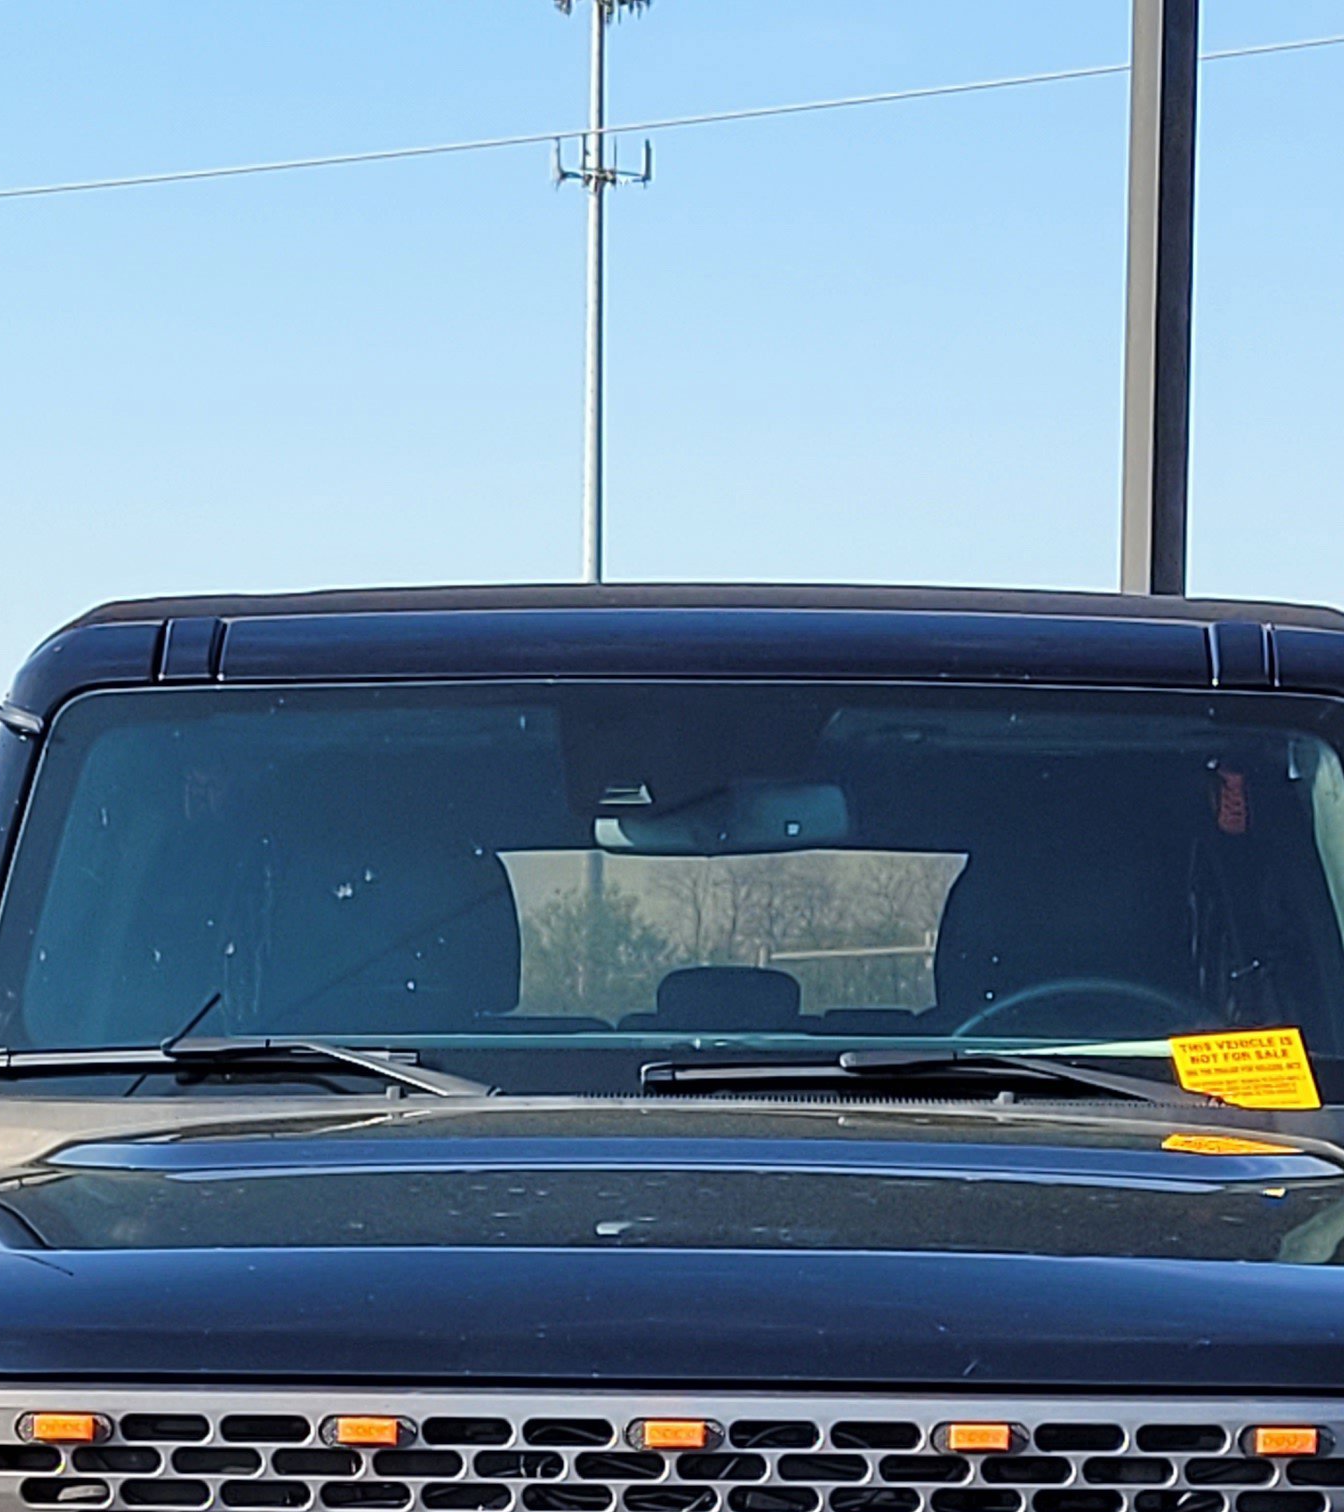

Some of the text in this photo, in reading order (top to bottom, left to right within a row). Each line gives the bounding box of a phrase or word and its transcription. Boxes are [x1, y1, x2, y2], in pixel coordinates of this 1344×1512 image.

[1179, 1036, 1293, 1053] THIS VEHICLE IS
[1190, 1048, 1289, 1065] NOT FOR SALE
